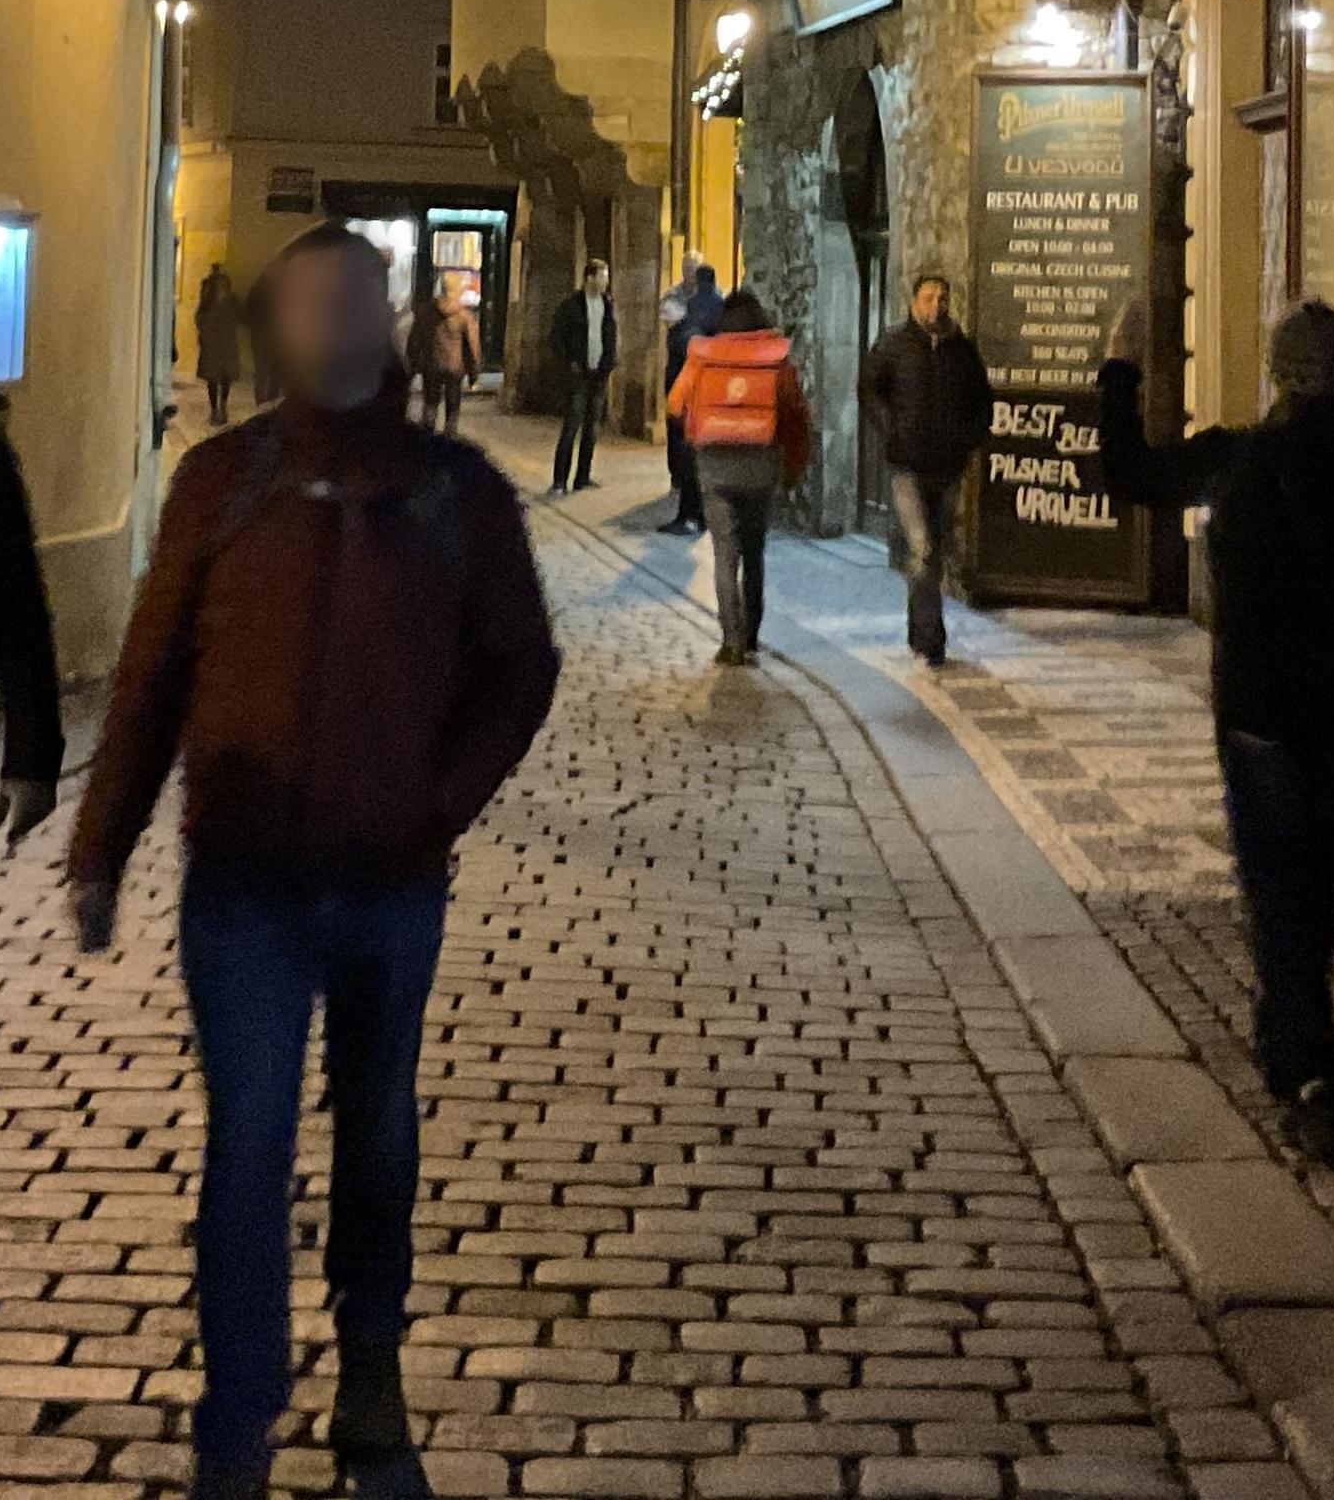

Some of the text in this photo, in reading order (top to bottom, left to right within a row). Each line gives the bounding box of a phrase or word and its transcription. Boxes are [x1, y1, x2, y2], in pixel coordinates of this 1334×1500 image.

[986, 191, 1139, 211] RESTAURANT & PUB
[1013, 216, 1110, 231] LUNCH & DINNER
[1008, 239, 1039, 254] OPEN
[990, 261, 1132, 278] ORIGINAL CZECH CUISINE
[1013, 284, 1062, 299] KITCHEN
[1076, 286, 1108, 300] OPEN
[989, 401, 1066, 438] BEST
[989, 453, 1081, 489] PILSNER
[1016, 485, 1118, 528] URQUELL
